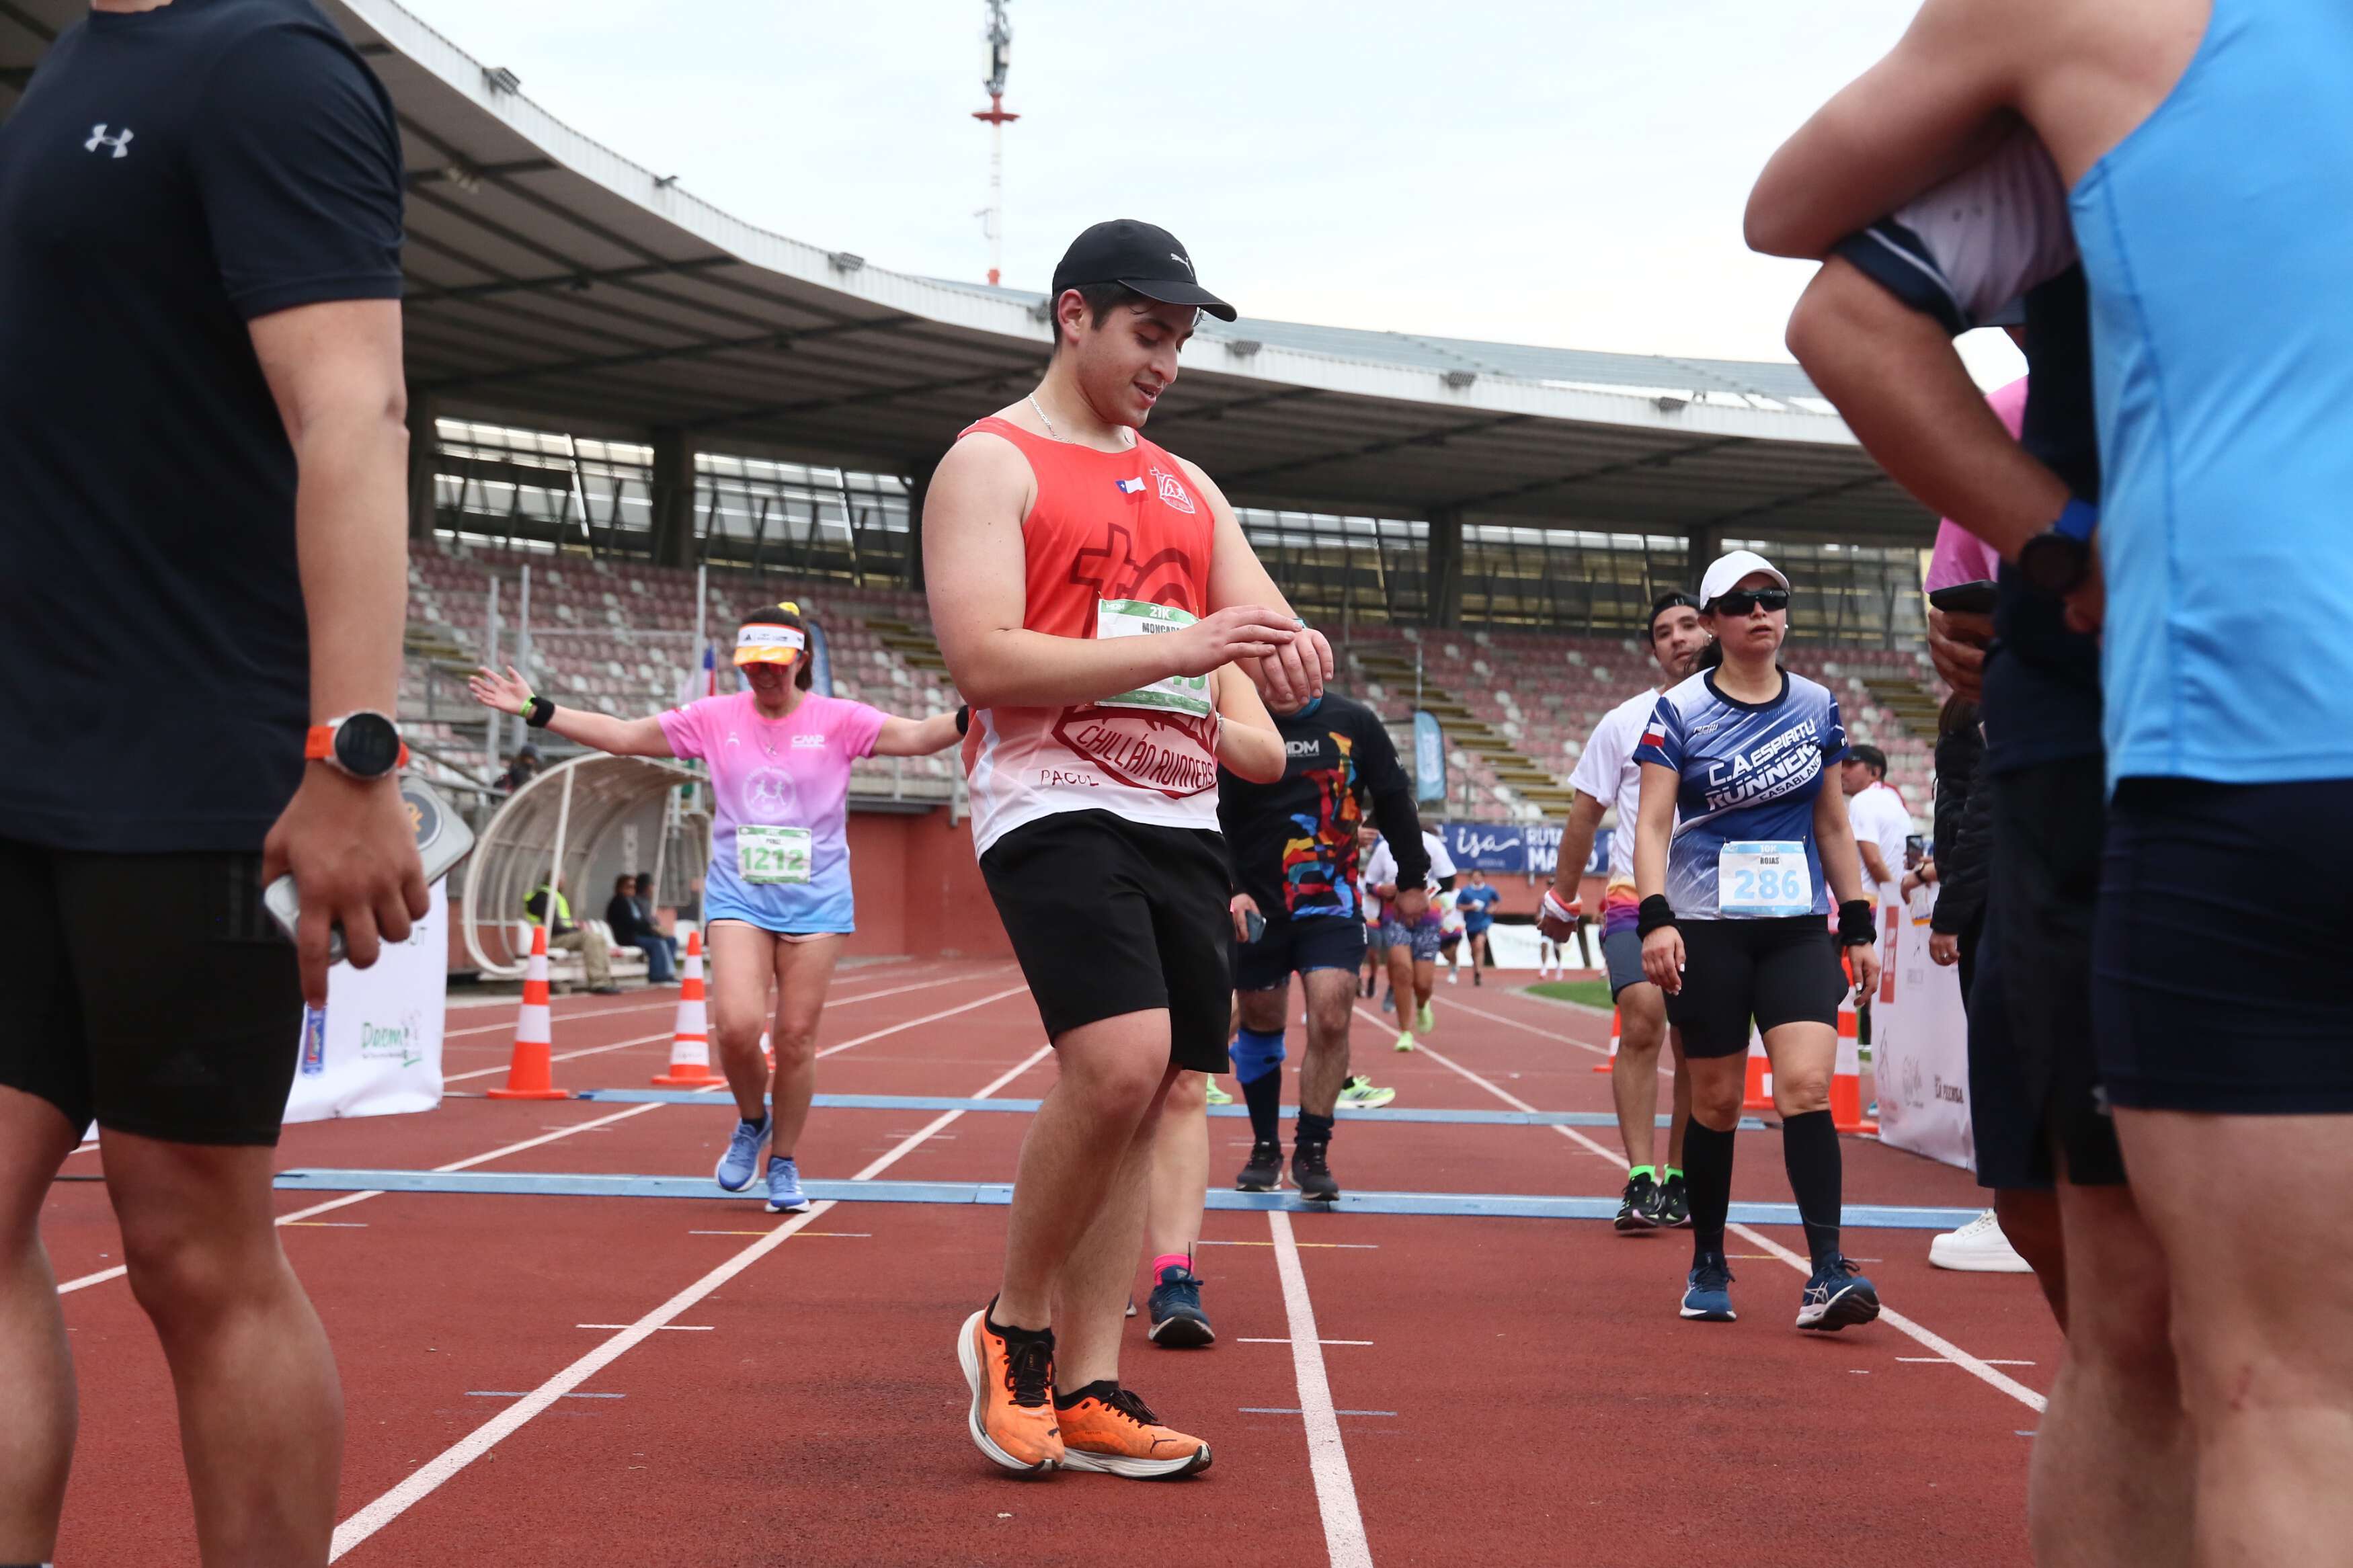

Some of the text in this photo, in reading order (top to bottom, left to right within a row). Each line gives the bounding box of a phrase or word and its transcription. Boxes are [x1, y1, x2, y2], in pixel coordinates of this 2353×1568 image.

[1149, 606, 1171, 619] 21K
[1076, 725, 1213, 789] CHILLÁN RUNNERS
[1751, 718, 1817, 768] ESPIRITU
[1705, 736, 1821, 811] RUNNERS
[1759, 755, 1821, 800] CASABLANC
[1457, 827, 1520, 858] isa
[1759, 844, 1777, 853] 10K
[742, 847, 804, 871] 1212
[1760, 857, 1780, 865] ROJAS
[1733, 870, 1800, 899] 286
